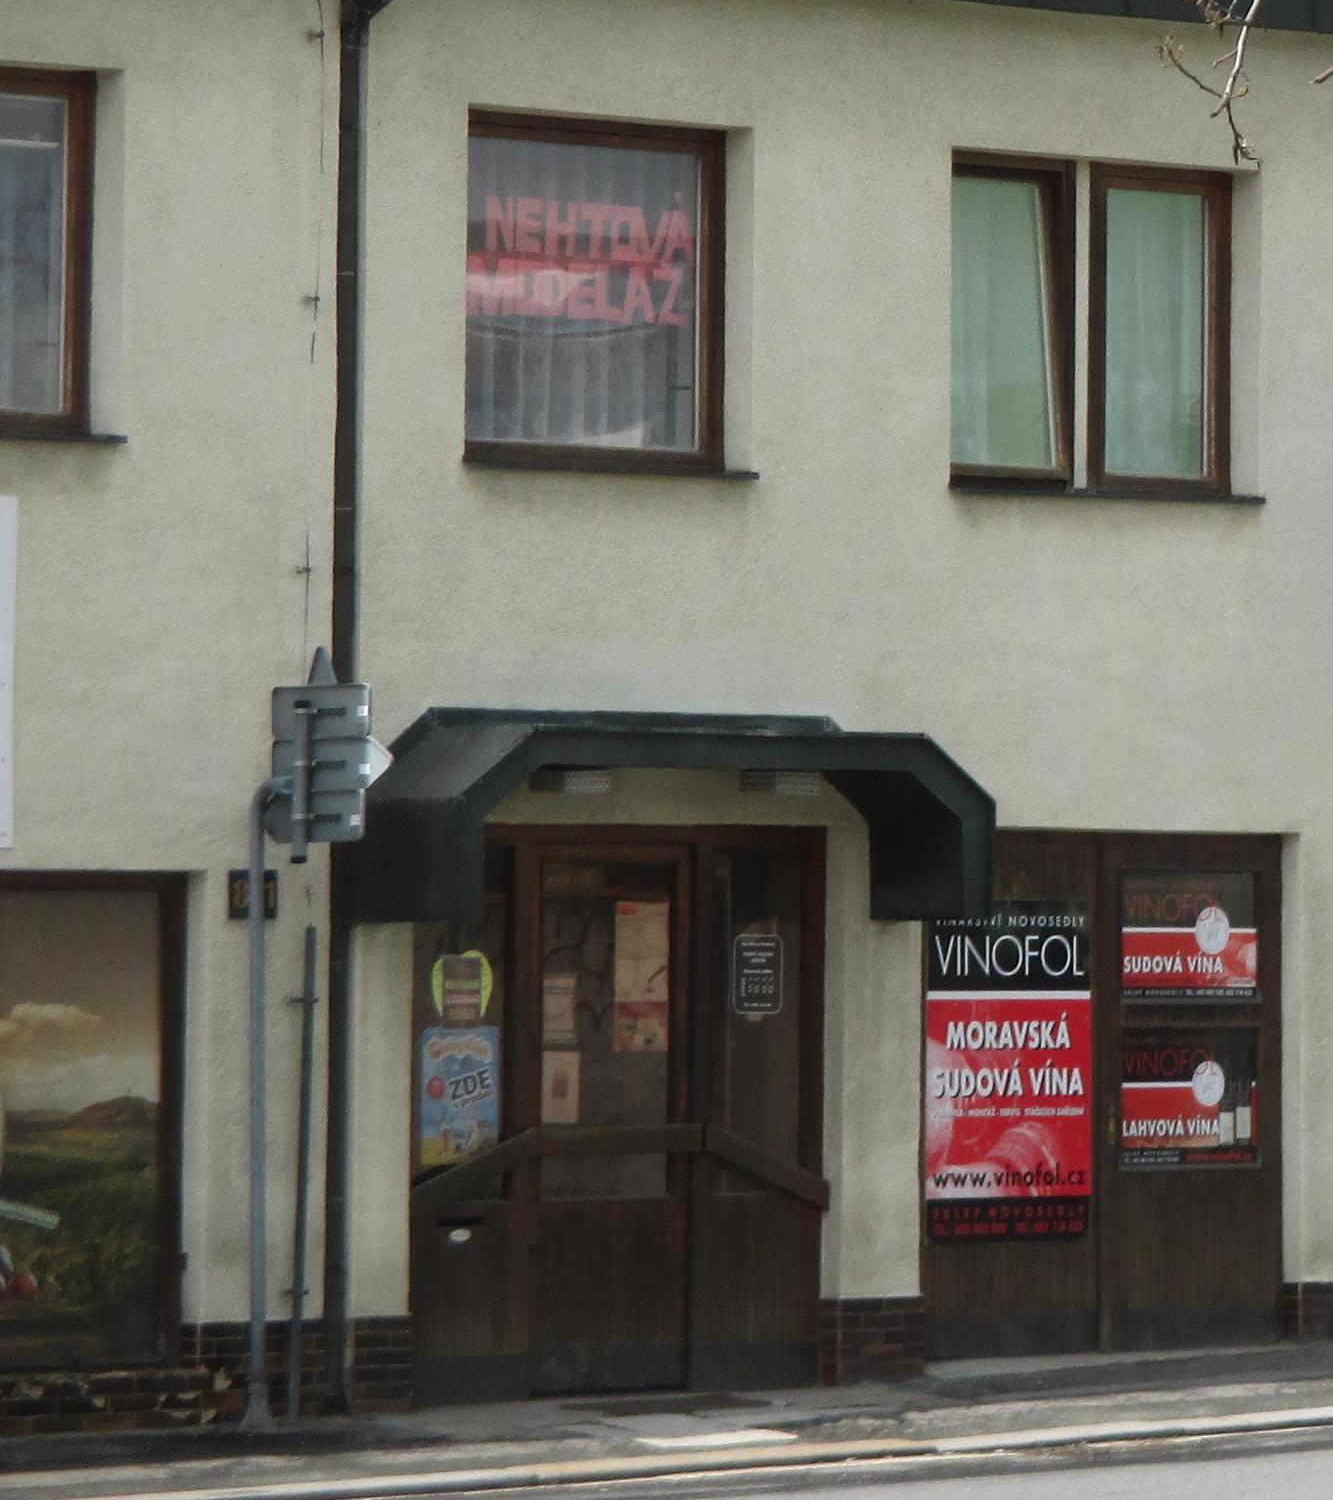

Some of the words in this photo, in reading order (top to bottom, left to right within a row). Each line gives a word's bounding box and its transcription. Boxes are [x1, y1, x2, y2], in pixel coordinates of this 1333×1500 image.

[1008, 914, 1085, 928] NOVOSEDLY
[935, 934, 1085, 976] VINOFOL
[1123, 950, 1182, 973] SUDOVÁ
[1187, 950, 1224, 973] VÍNA
[947, 1011, 1072, 1050] MORAVSKÁ
[449, 1068, 491, 1100] ZDE
[932, 1059, 1024, 1098] SUDOVÁ
[1029, 1059, 1085, 1097] VÍNA
[1123, 1113, 1184, 1137] LAHVOVÁ
[1187, 1113, 1220, 1136] VÍNA
[933, 1162, 1085, 1188] www.vinofol.cz
